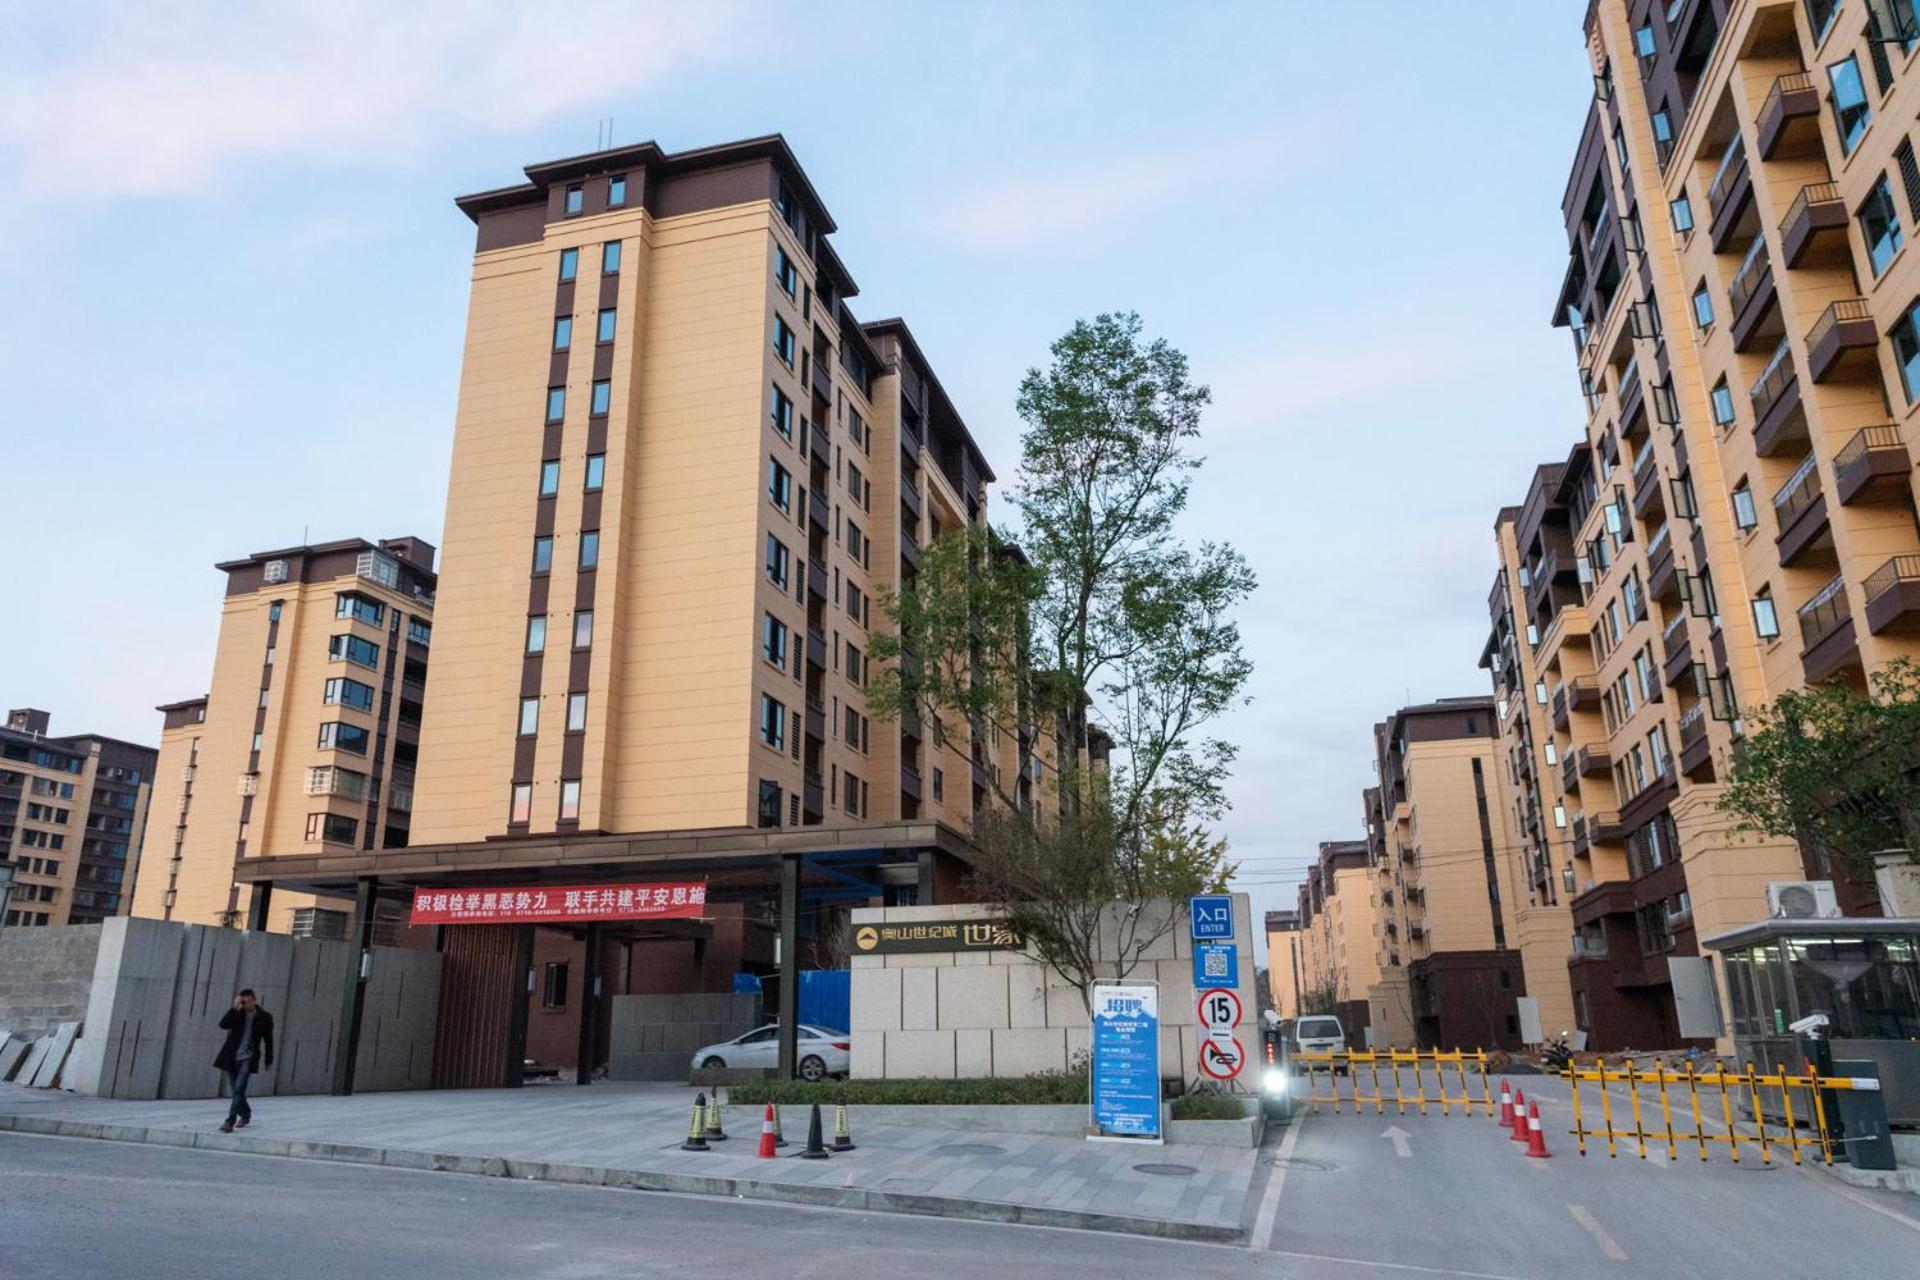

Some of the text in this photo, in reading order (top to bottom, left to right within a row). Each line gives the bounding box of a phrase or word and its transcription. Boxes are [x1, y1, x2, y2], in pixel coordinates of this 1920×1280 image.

[416, 886, 705, 912] 积极检举黑恶势力 联手共建平安恩施
[1197, 907, 1227, 922] 入口
[1200, 924, 1225, 933] ENTER
[1209, 997, 1231, 1023] 15
